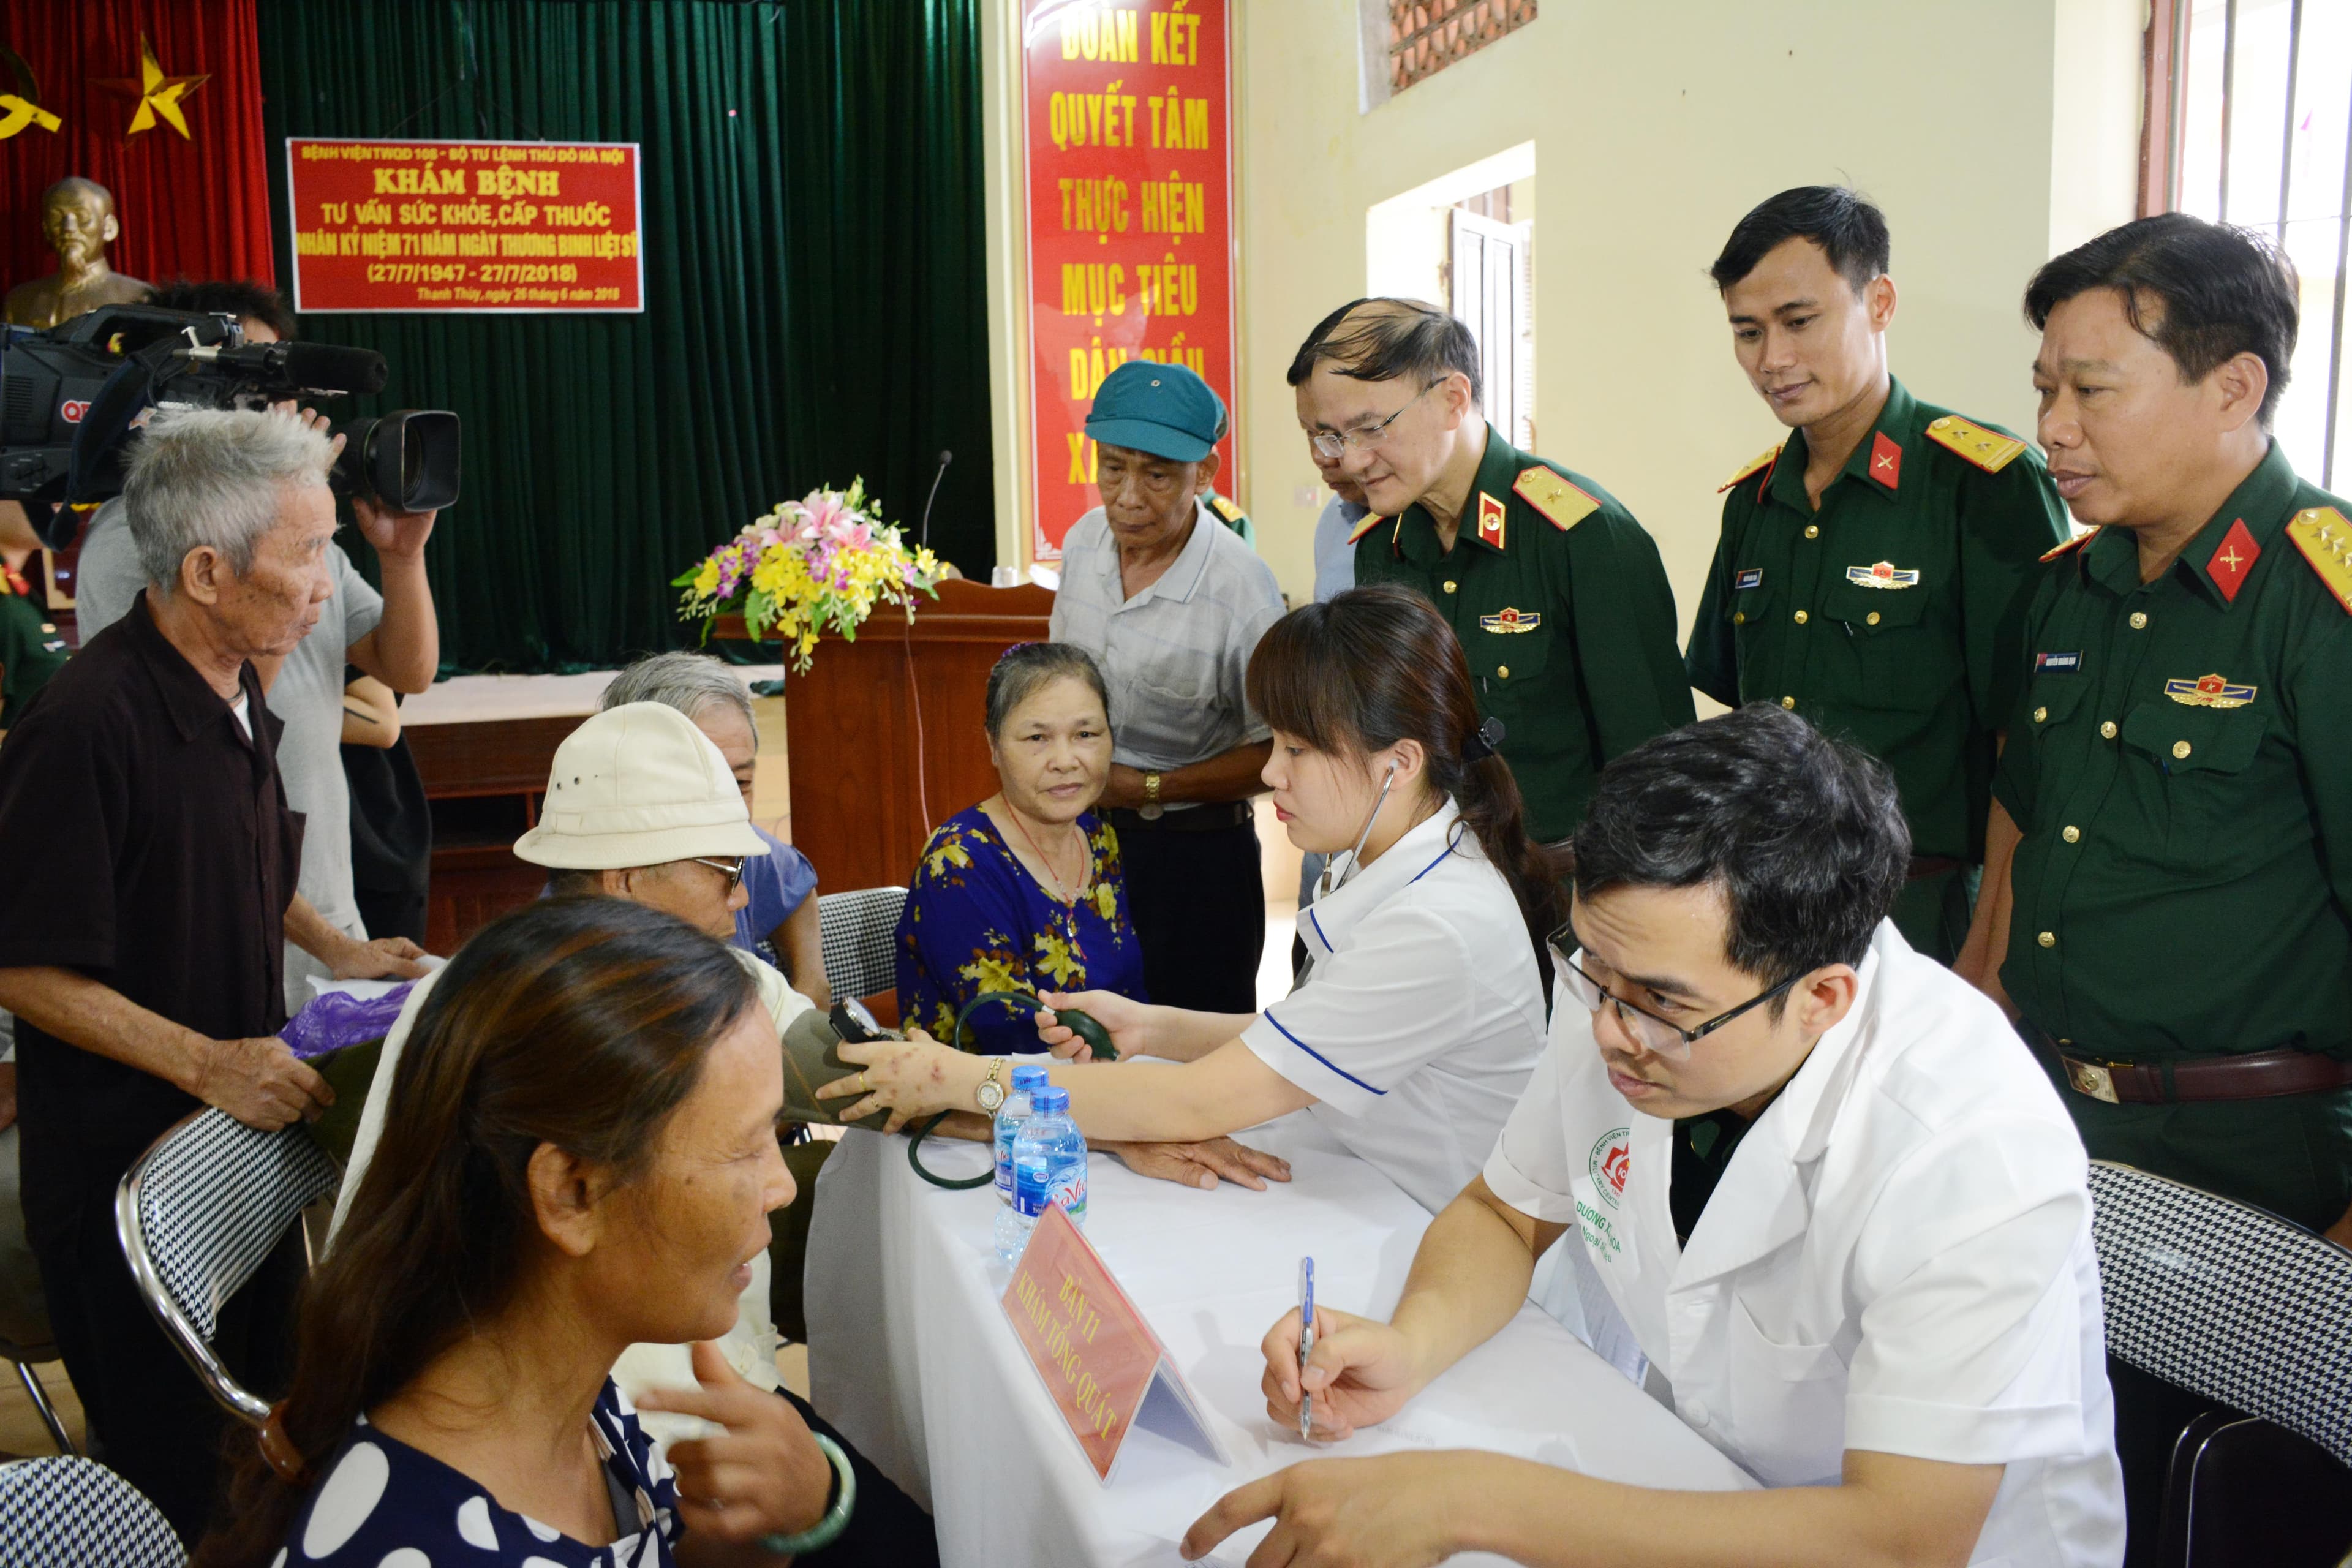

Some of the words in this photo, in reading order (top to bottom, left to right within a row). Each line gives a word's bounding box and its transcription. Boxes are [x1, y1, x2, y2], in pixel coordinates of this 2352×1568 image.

[1150, 0, 1201, 66] KẾT
[1050, 79, 1137, 151] QUYẾT
[1148, 85, 1209, 150] TÂM
[373, 160, 467, 195] KHÁM
[476, 164, 560, 200] BỆNH
[448, 145, 468, 164] BỘ
[470, 147, 490, 162] TƯ
[320, 201, 349, 224] TƯ
[353, 198, 393, 225] VẤN
[399, 198, 438, 225] SỨC
[543, 200, 611, 227] THUỐC
[1058, 175, 1129, 244] THỰC
[1141, 170, 1205, 244] HIỆN
[339, 224, 360, 256] KỶ
[402, 233, 420, 256] 71
[421, 229, 457, 257] NĂM
[458, 229, 498, 257] NGÀY
[557, 233, 594, 257] BINH
[593, 229, 621, 261] LIỆT
[368, 263, 467, 284] (27/7/1947
[480, 263, 578, 284] 27/7/2018)
[1061, 263, 1126, 327] MỤC
[1136, 252, 1198, 316] TIÊU
[1058, 1273, 1089, 1324] BÀN
[1081, 1311, 1101, 1344] 11
[1016, 1269, 1052, 1333] KHÁM
[1045, 1317, 1082, 1384] TỔNG
[1076, 1371, 1117, 1441] QUÁT
